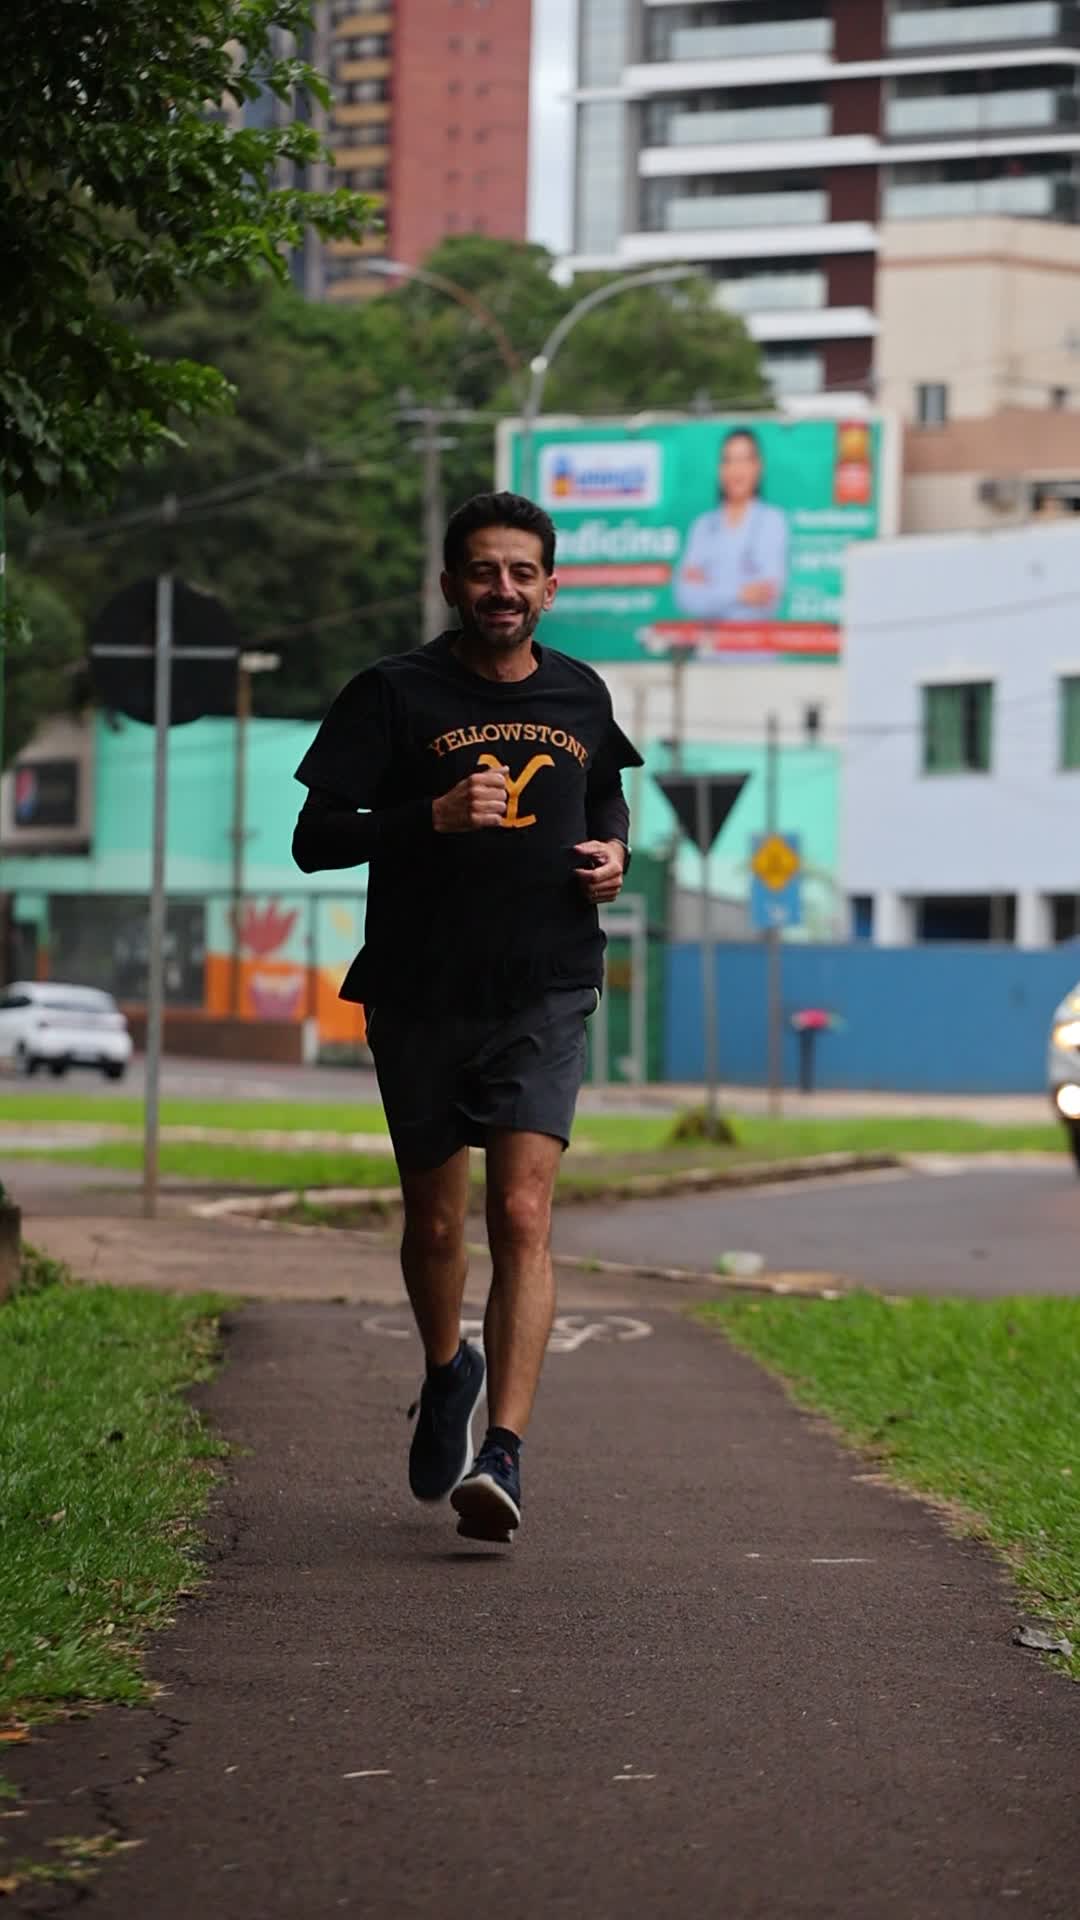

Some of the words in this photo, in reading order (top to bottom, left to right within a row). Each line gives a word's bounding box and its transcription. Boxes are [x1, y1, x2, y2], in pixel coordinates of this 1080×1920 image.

[555, 518, 680, 558] edicina
[428, 723, 589, 768] YELLOWSTONE
[477, 753, 556, 828] Y
